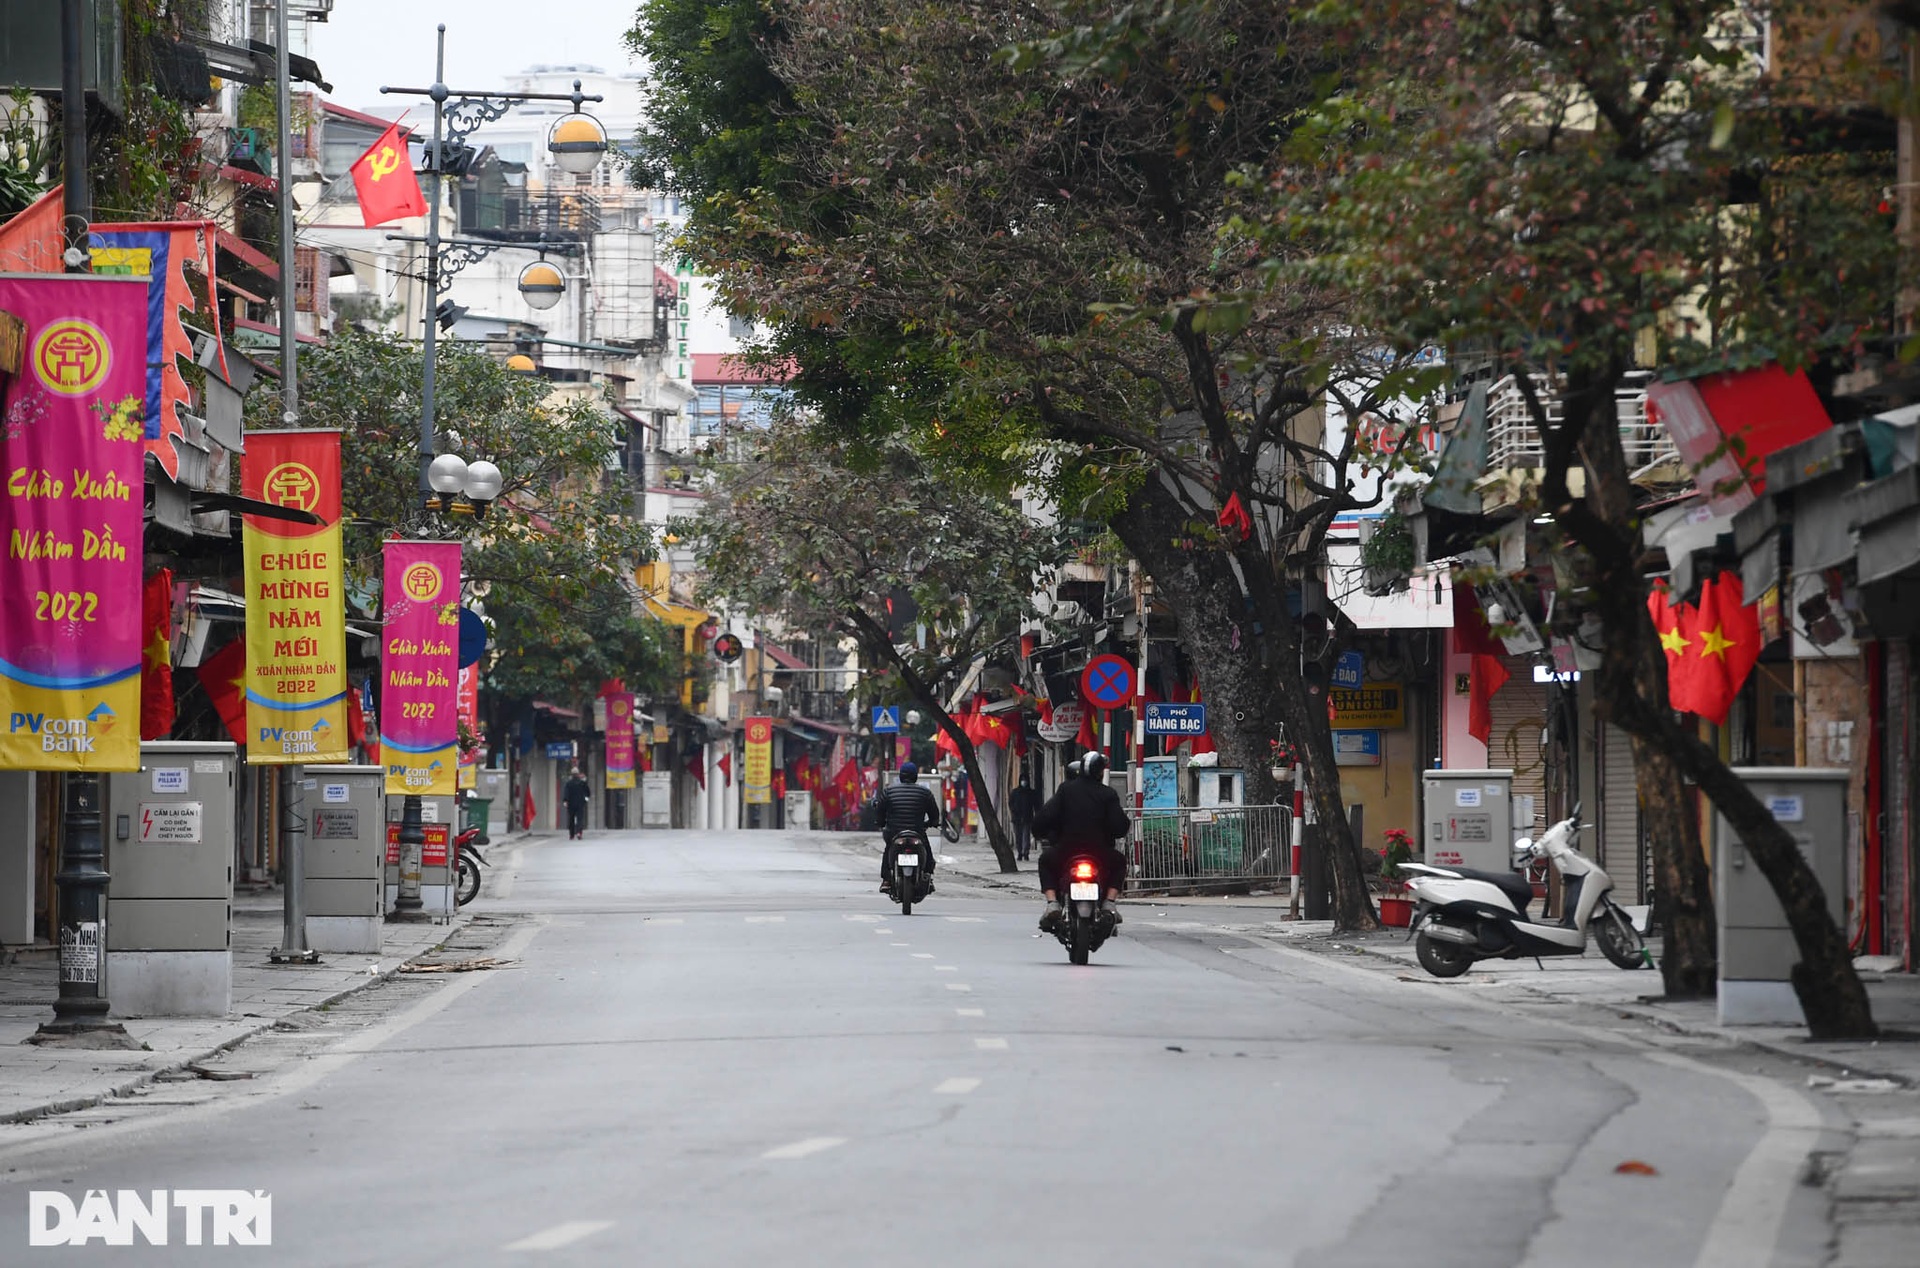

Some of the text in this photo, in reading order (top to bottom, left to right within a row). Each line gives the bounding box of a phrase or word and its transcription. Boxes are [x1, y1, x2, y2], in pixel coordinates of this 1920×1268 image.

[679, 281, 690, 379] HOTEL
[8, 467, 130, 500] Chào Xuân
[10, 523, 126, 561] Nhâm Dần
[260, 549, 327, 571] CHÚC
[260, 578, 329, 600] MỪNG
[35, 591, 98, 622] 2022
[269, 607, 322, 629] NĂM
[274, 636, 318, 657] MỚI
[389, 638, 451, 656] Chào Xuân
[256, 664, 282, 676] XUÂN
[389, 667, 449, 687] Nhâm Dần
[277, 680, 316, 694] 2022
[402, 702, 435, 718] 2022
[1170, 707, 1188, 716] PHỐ
[10, 712, 87, 734] PVcom
[1149, 716, 1201, 733] HÀNG BẠC
[260, 727, 312, 742] PVcom
[42, 735, 96, 752] Bank
[282, 740, 318, 754] Bank
[389, 764, 429, 777] PVcom
[405, 775, 433, 786] Bank
[154, 808, 168, 816] CẤM
[428, 832, 443, 842] CẤM
[79, 926, 97, 945] NHÀ
